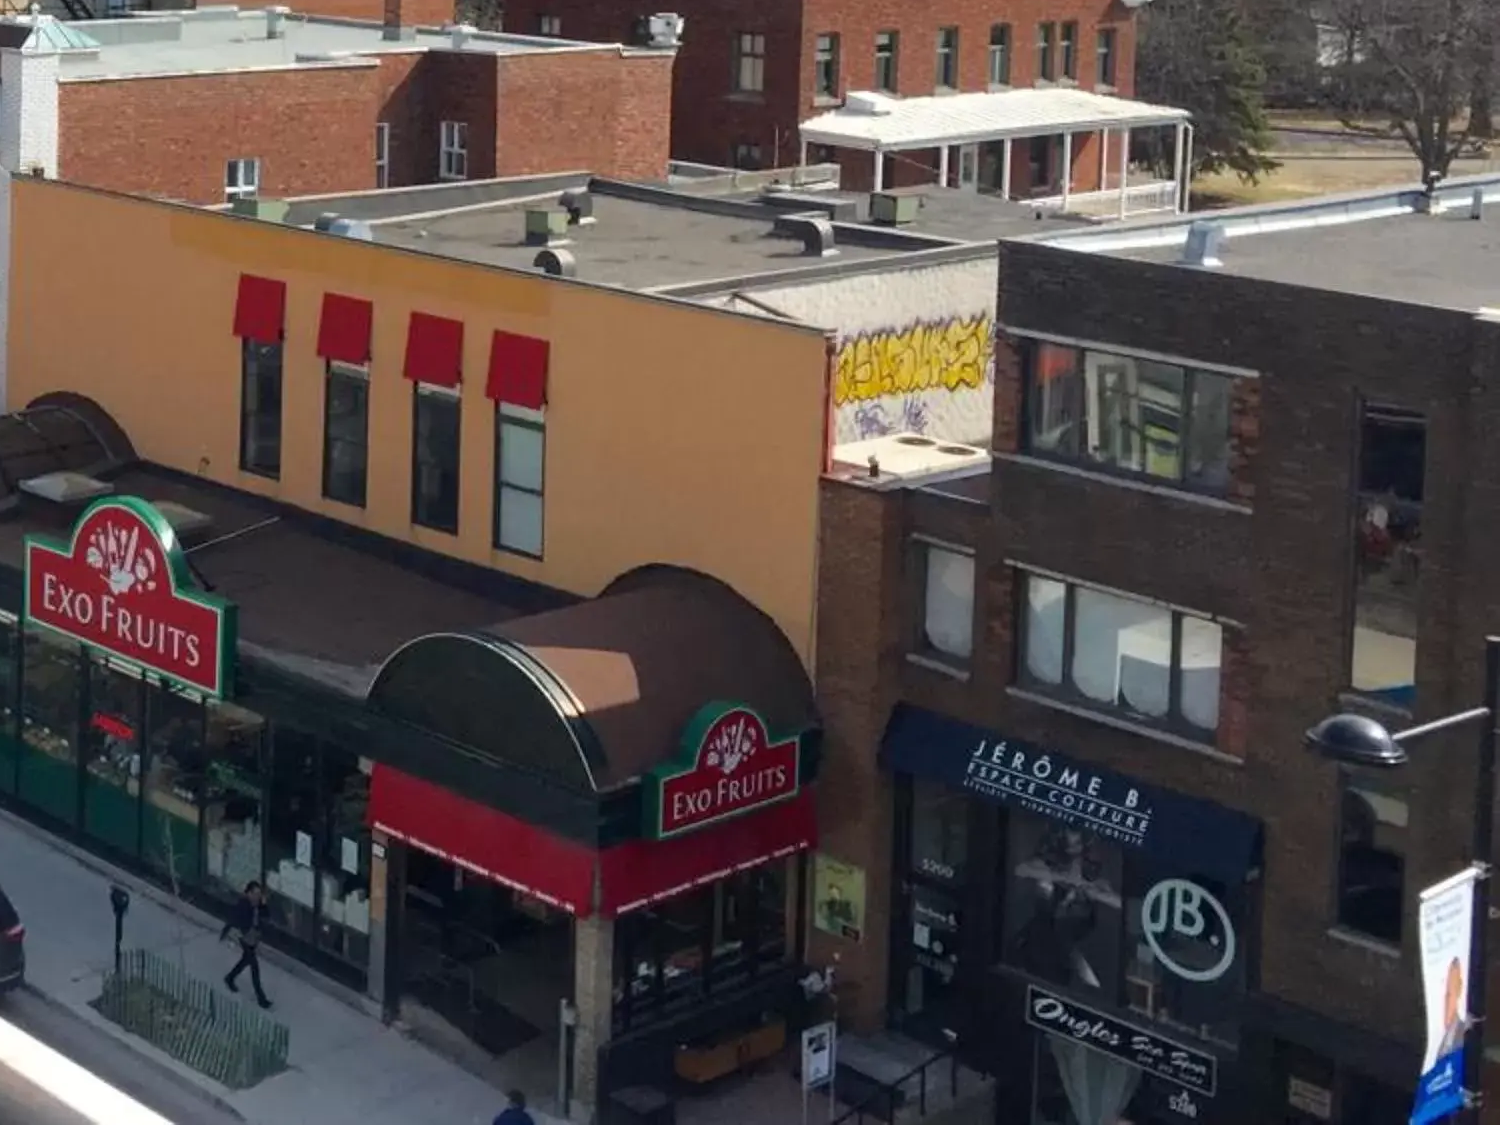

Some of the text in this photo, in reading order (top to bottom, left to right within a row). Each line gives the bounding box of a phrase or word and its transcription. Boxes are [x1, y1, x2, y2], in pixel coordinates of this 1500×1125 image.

[43, 572, 201, 668] EXO FRUITS
[672, 764, 787, 821] EXO FRUITS
[973, 739, 1103, 796] JÉRÔME
[966, 762, 1150, 832] ESPACE COIFFURE
[1033, 997, 1120, 1046] Ongles
